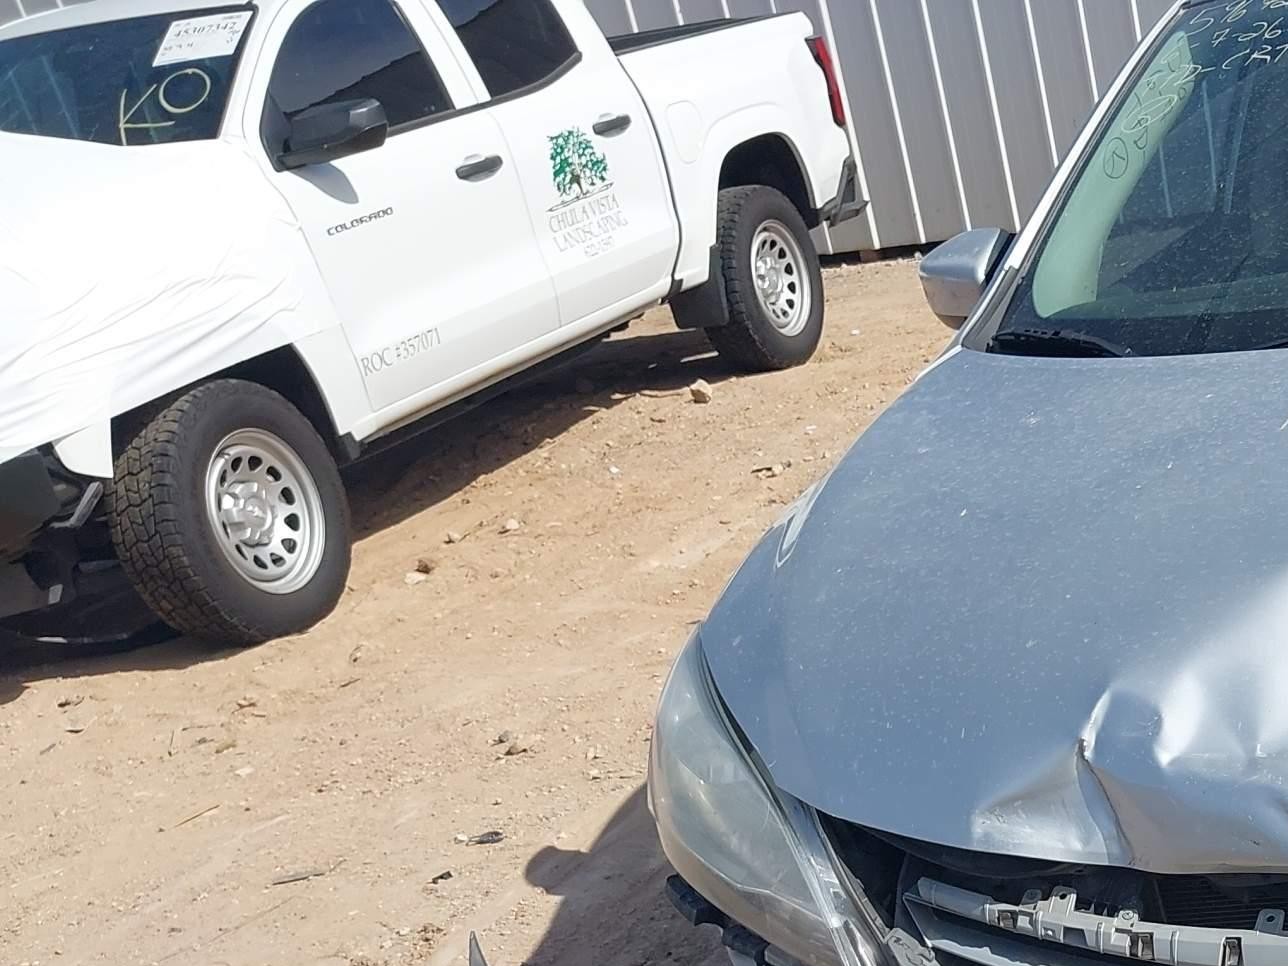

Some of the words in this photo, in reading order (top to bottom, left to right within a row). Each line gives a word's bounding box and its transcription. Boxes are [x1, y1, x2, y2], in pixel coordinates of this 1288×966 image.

[118, 68, 211, 146] KO
[326, 206, 394, 236] COLORADO
[549, 205, 590, 232] CHULA
[589, 193, 619, 215] VISTA
[553, 210, 628, 252] LANDSCAPING
[360, 347, 393, 376] ROC
[395, 327, 441, 359] #357071
